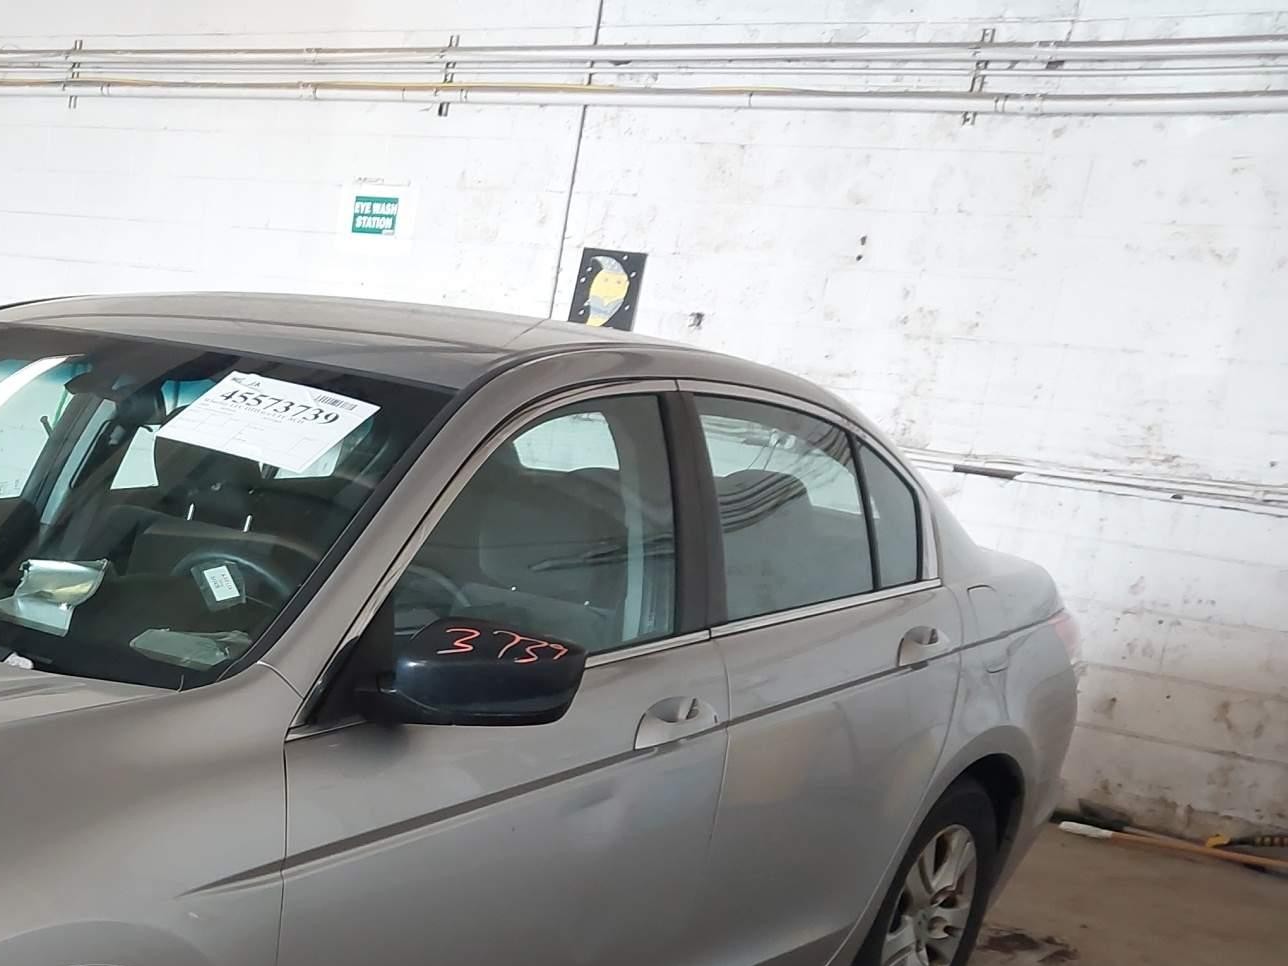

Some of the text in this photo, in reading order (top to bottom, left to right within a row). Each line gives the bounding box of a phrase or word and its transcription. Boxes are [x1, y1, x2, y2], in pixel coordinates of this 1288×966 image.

[354, 201, 398, 215] EYE WASH
[355, 216, 393, 229] STATION
[220, 390, 340, 425] 45573739
